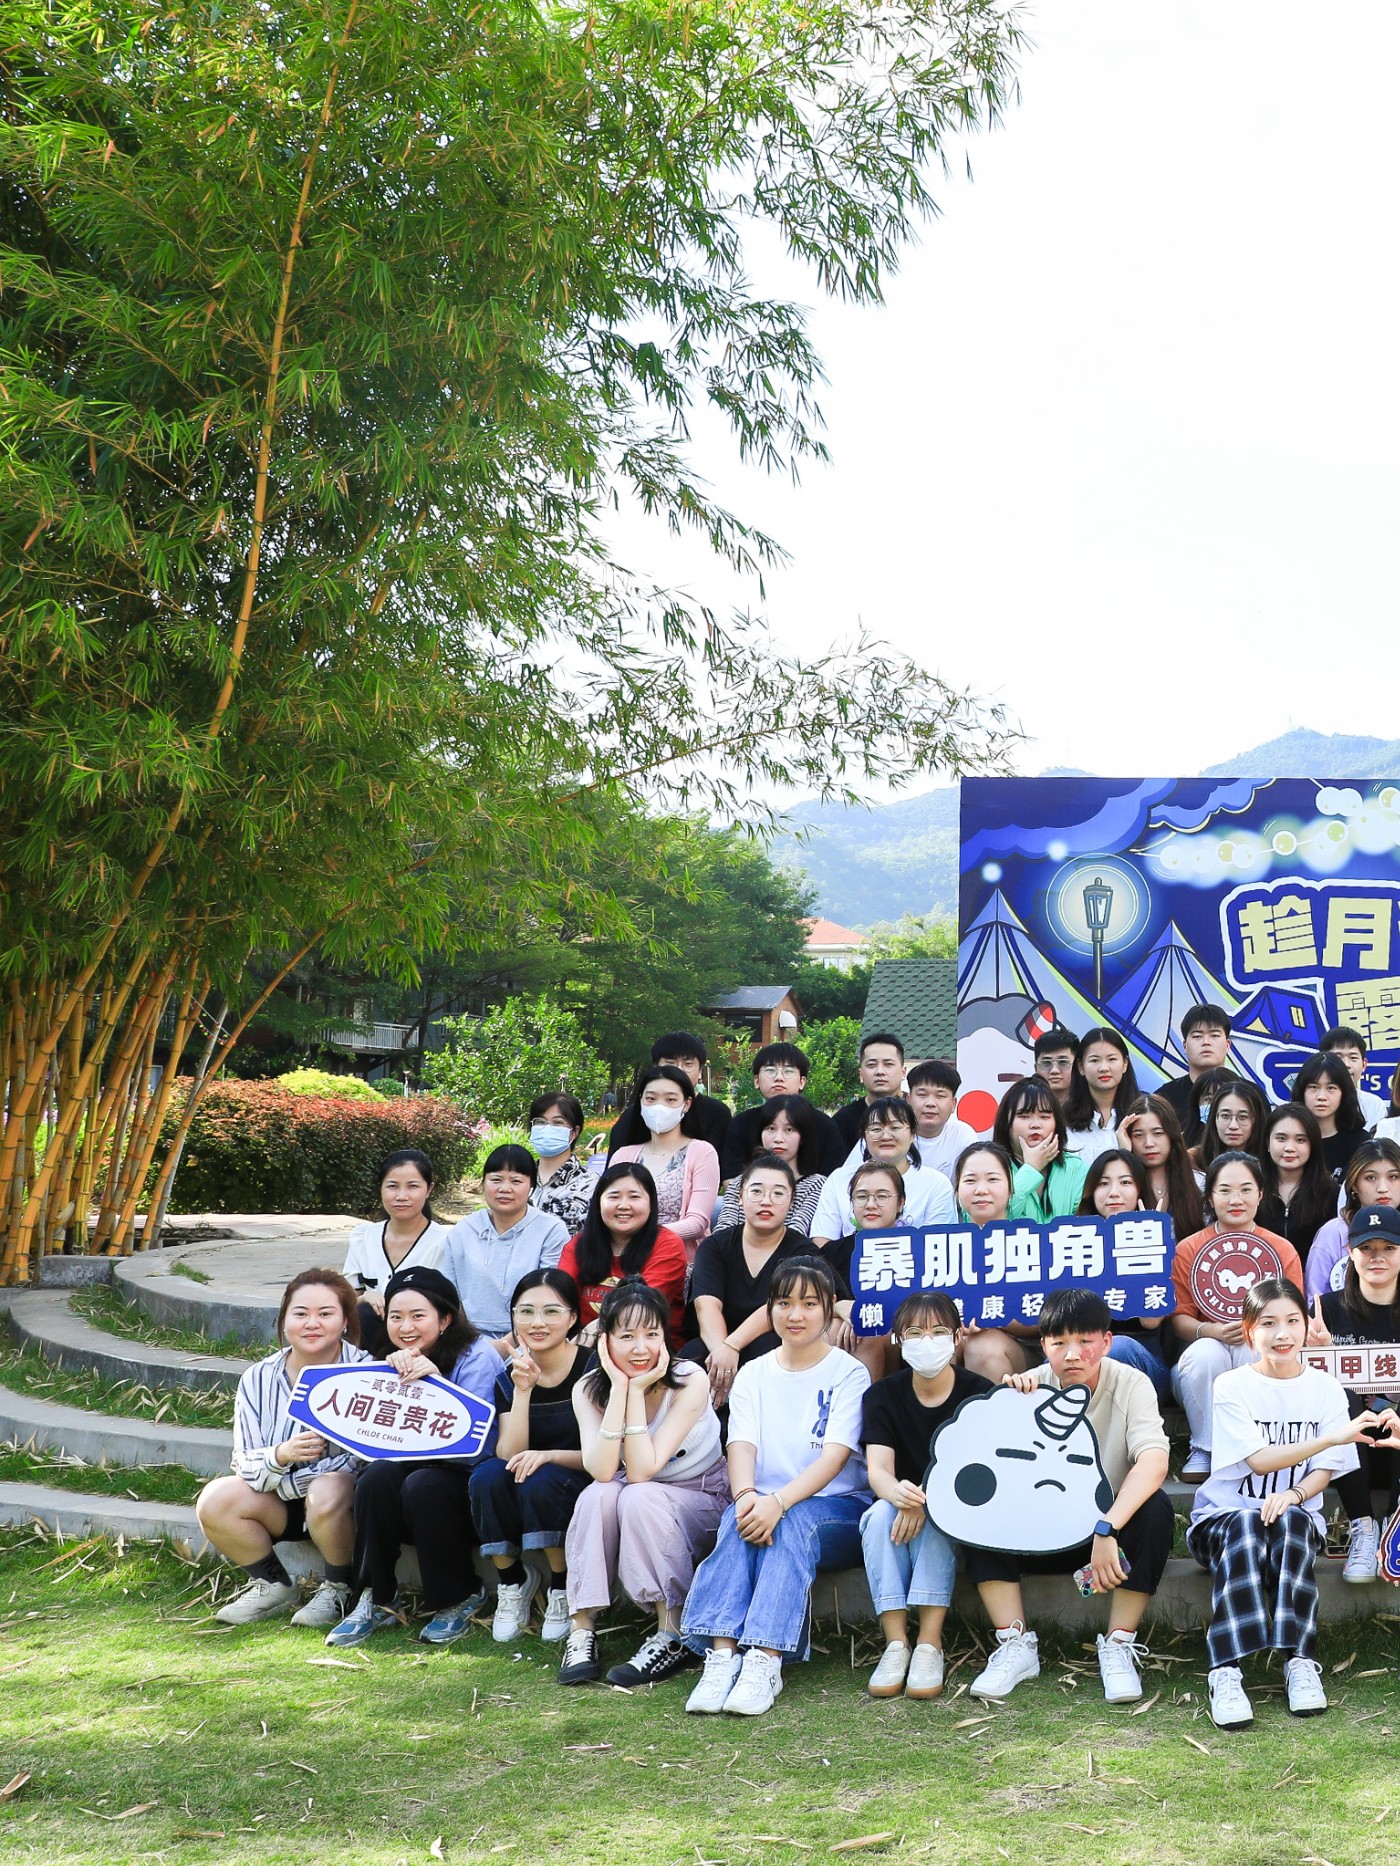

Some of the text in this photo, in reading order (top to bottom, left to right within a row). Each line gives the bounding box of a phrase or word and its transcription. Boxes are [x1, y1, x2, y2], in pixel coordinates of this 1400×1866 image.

[1368, 1214, 1382, 1226] R
[858, 1219, 1167, 1292] 暴肌独角兽
[316, 1388, 458, 1440] 人间富贵花
[356, 1428, 404, 1443] CHLOE CHAN
